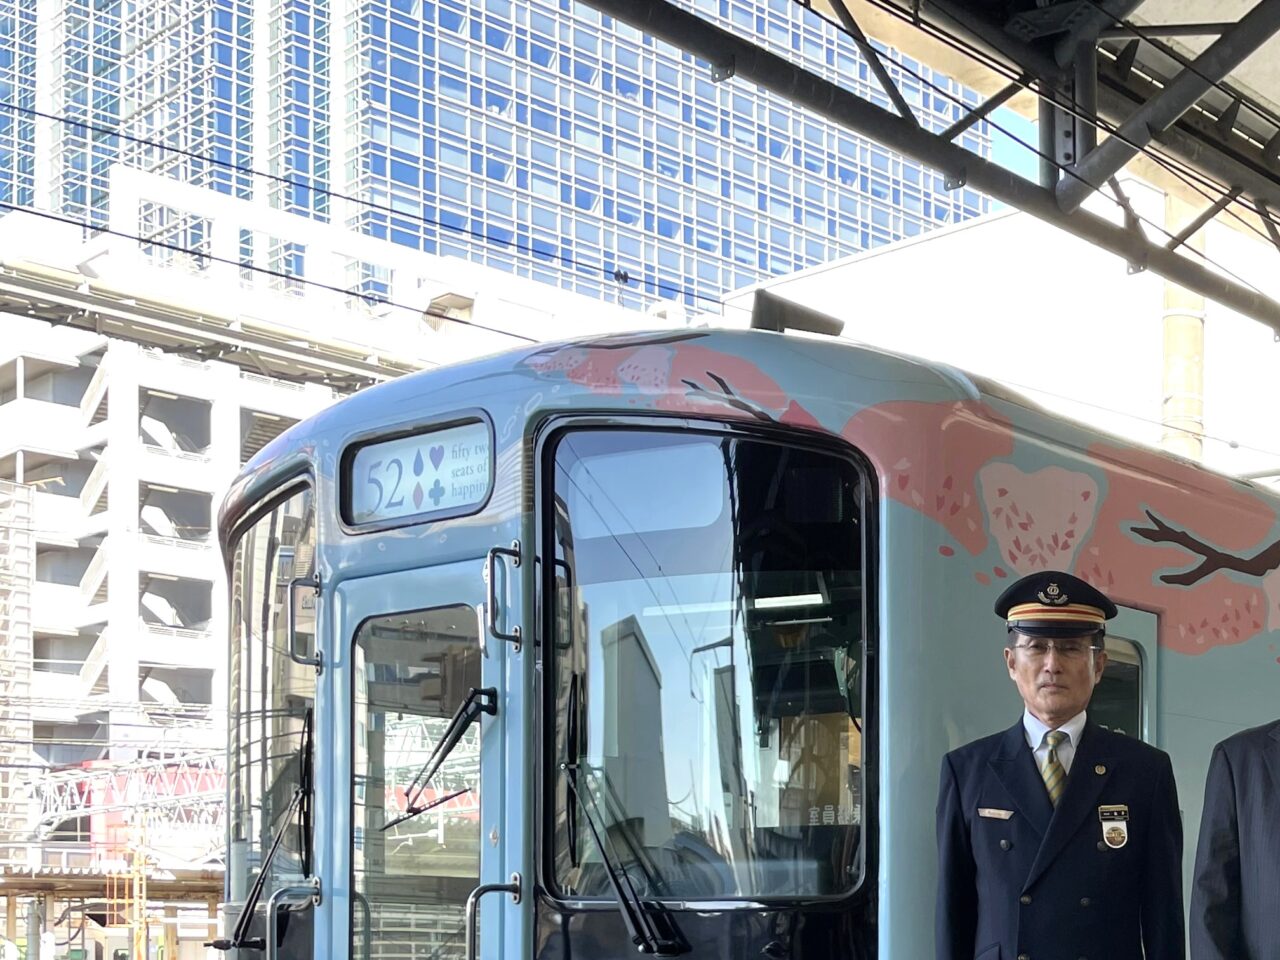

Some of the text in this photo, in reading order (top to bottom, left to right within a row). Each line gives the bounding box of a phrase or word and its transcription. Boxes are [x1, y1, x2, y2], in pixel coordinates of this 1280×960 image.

[451, 444, 472, 460] fifty
[451, 465, 474, 479] seats
[366, 458, 405, 517] 52
